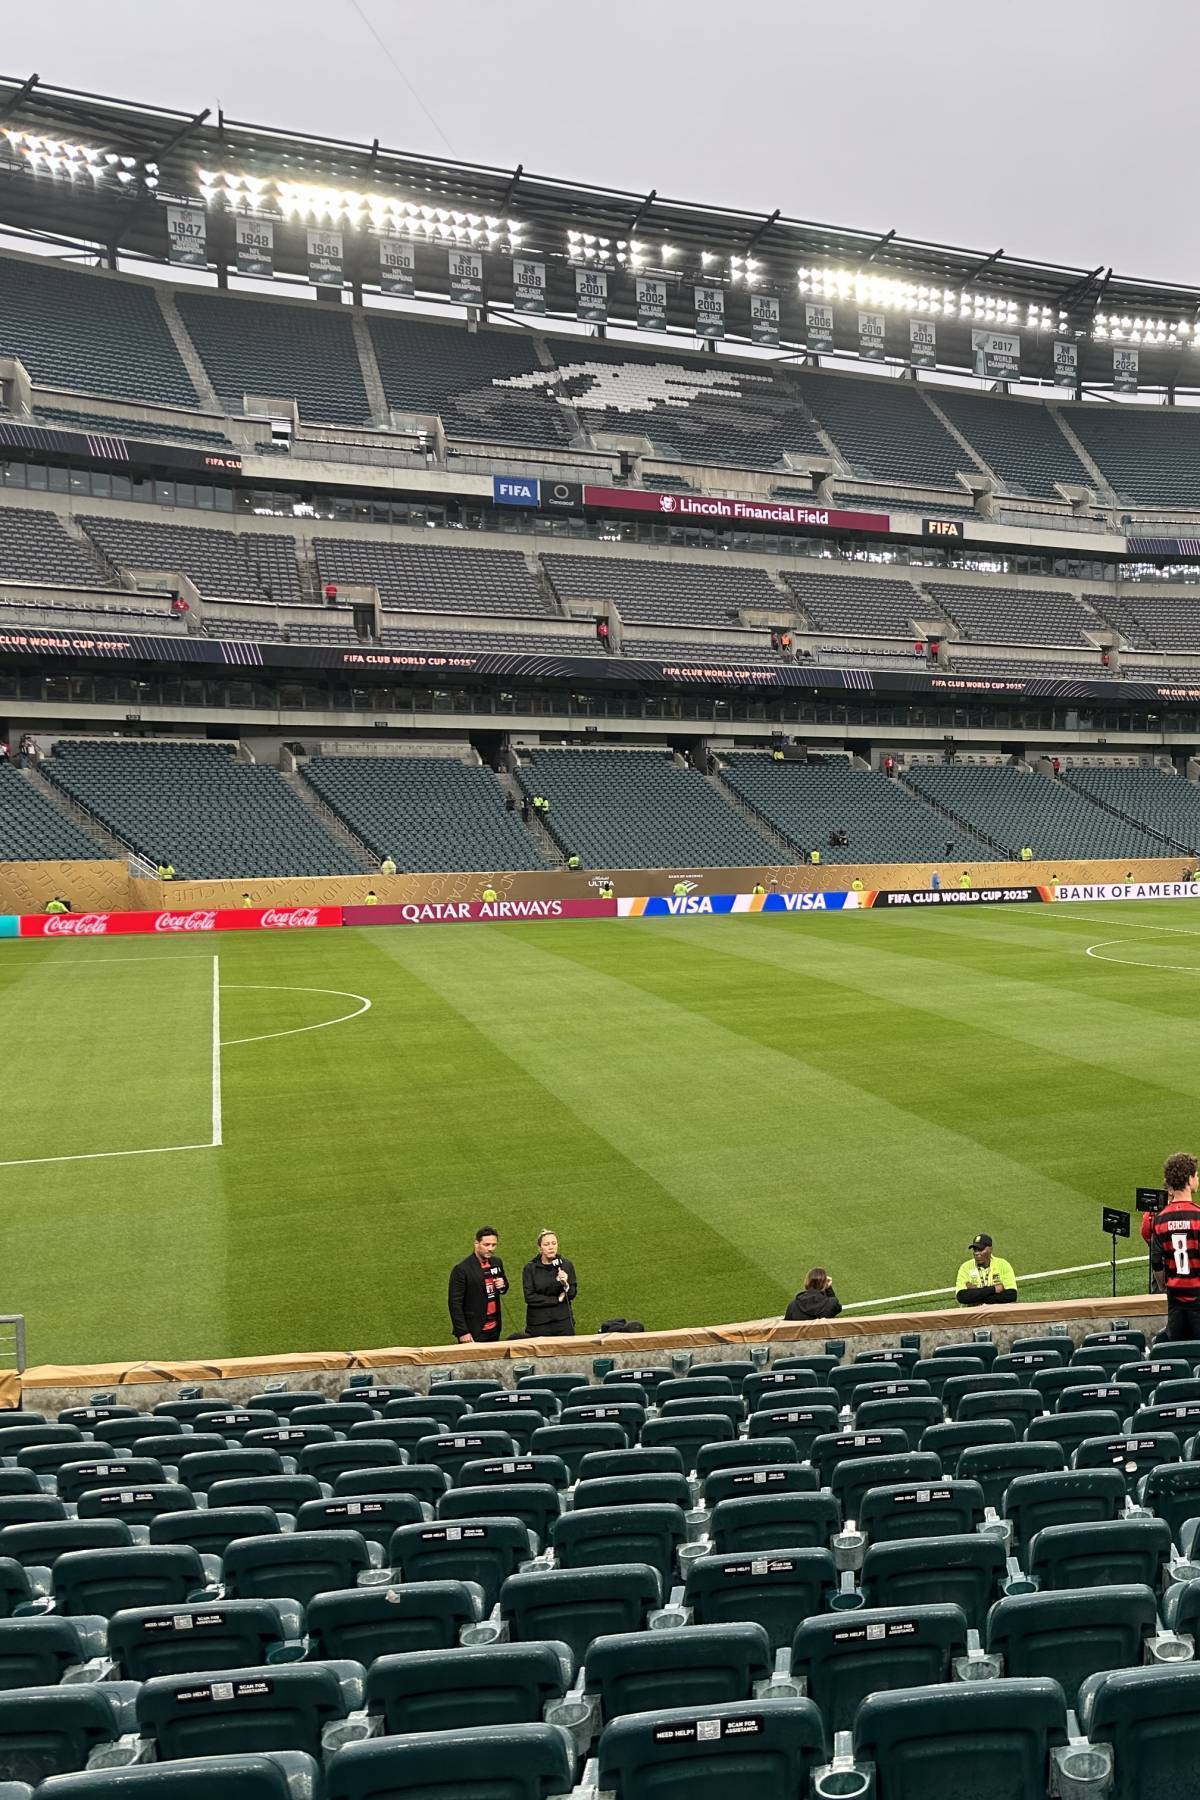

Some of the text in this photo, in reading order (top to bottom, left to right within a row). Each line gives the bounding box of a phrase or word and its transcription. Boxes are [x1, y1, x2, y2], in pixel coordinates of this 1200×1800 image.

[172, 221, 201, 236] 1947
[241, 233, 268, 246] 1948
[312, 243, 339, 256] 1949
[385, 254, 410, 267] 1960
[453, 264, 479, 277] 1980
[517, 273, 542, 286] 1988
[580, 283, 603, 295] 2001
[639, 291, 664, 304] 2002
[697, 299, 721, 312] 2003
[753, 307, 777, 319] 2004
[808, 315, 831, 327] 2006
[862, 323, 881, 335] 2010
[913, 332, 933, 343] 2013
[992, 340, 1013, 352] 2017
[993, 355, 1013, 364] WORLD
[1056, 353, 1075, 364] 2019
[1115, 359, 1137, 371] 2022
[987, 360, 1018, 371] CHAMPIONS
[205, 457, 242, 469] FIFA CLU
[500, 484, 531, 497] FIFA
[680, 498, 829, 525] Lincoln Financial Field
[928, 521, 958, 536] FIFA
[0, 635, 27, 645] CLUB
[30, 637, 70, 647] WORLD
[73, 640, 95, 648] CUP
[343, 655, 364, 663] FIFA
[366, 655, 391, 664] CLUB
[392, 656, 426, 665] WORLD
[662, 667, 680, 675] FIFA
[681, 668, 703, 676] CLUB
[703, 669, 733, 677] WORLD
[947, 680, 965, 688] CLUB
[888, 892, 911, 904] FIFA
[913, 891, 940, 903] CLUB
[941, 891, 980, 902] WORLD
[981, 890, 1001, 901] CUP
[1059, 887, 1105, 900] BANK
[1111, 886, 1132, 898] OF
[661, 896, 714, 914] VISA
[779, 893, 827, 910] VISA
[260, 907, 321, 927] Coca-Cola
[401, 900, 563, 923] QATAR AIRWAYS
[43, 914, 110, 936] Coca-Cola
[155, 910, 218, 932] Coca-Cola
[1171, 1233, 1190, 1275] 8
[657, 1729, 694, 1739] NEED HELP?
[725, 1726, 758, 1734] ASSISTANCE
